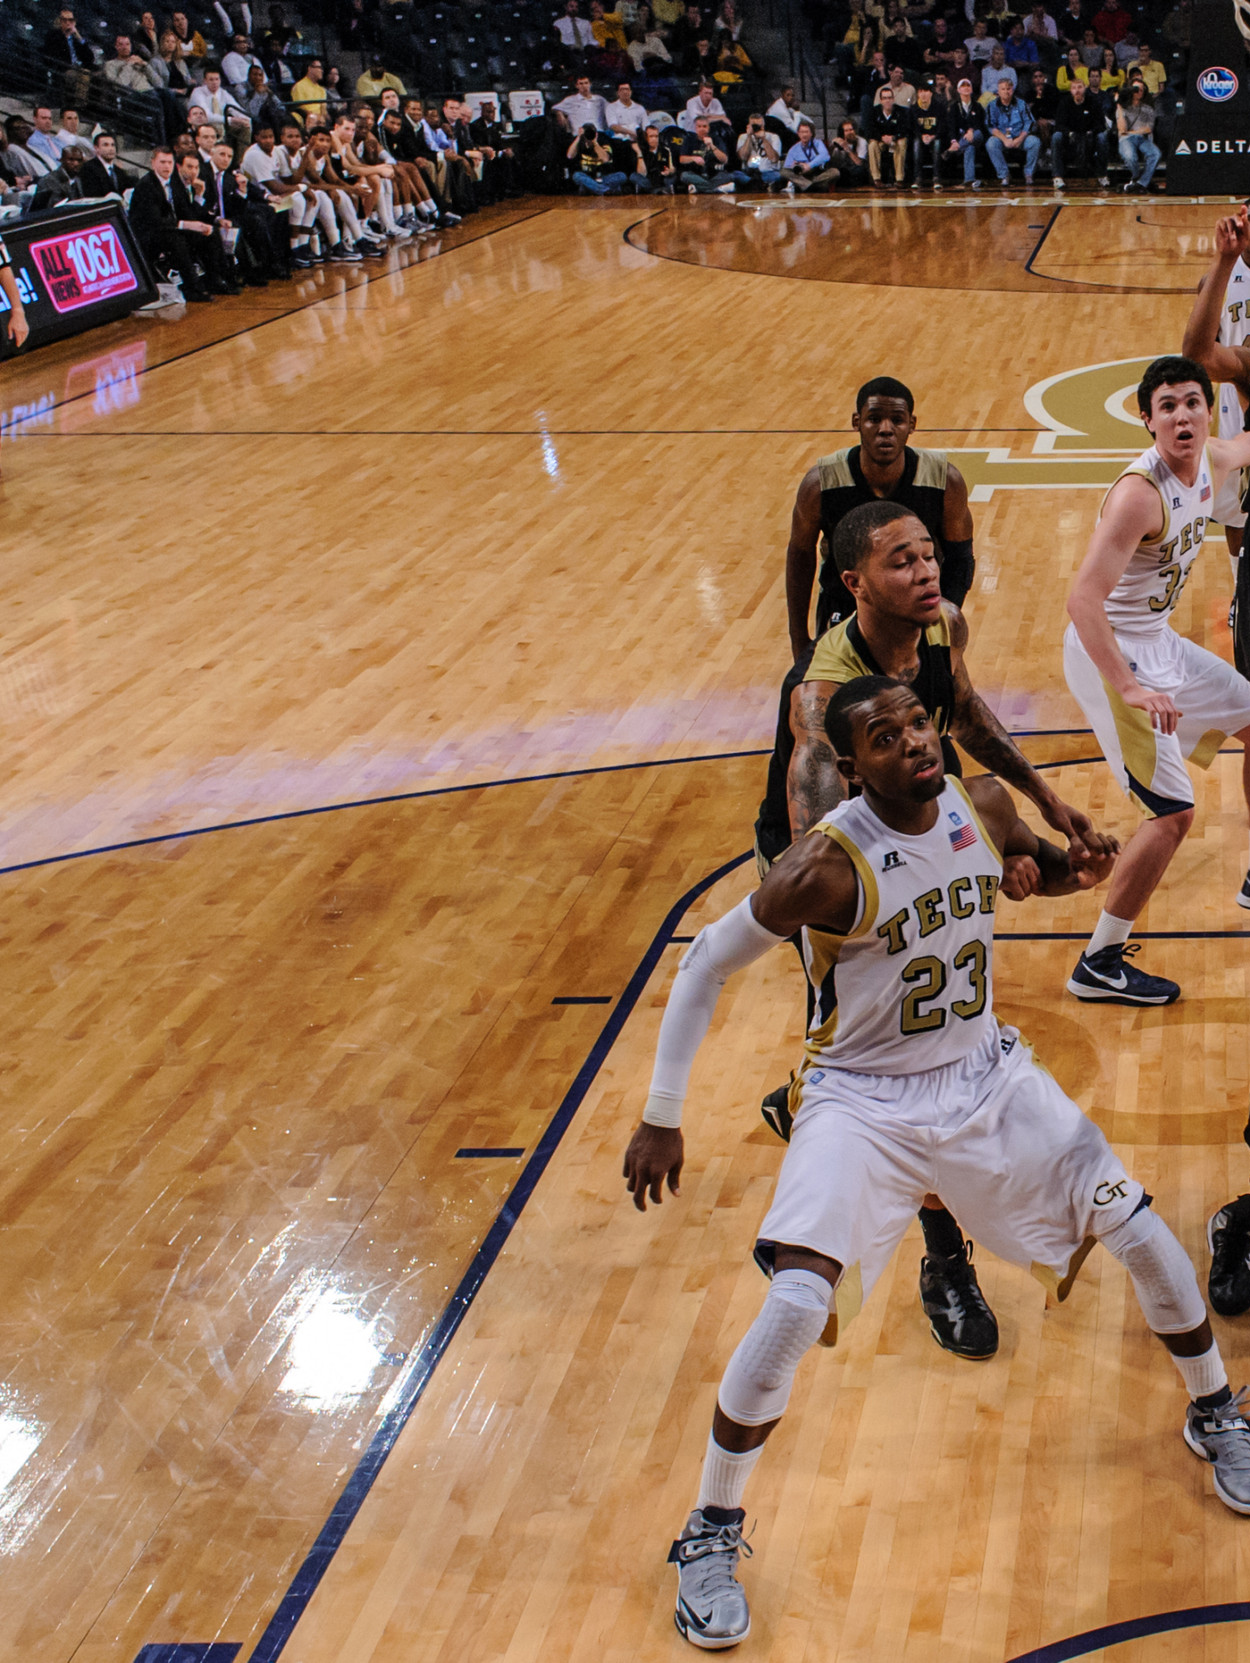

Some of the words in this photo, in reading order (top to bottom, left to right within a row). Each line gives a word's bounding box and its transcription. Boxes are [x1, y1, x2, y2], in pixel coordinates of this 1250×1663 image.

[1202, 72, 1235, 97] Kroger
[40, 245, 72, 281] ALL
[66, 230, 121, 284] 106.7
[51, 276, 81, 303] NEWS
[1158, 516, 1211, 564] TEC
[877, 874, 1000, 956] TECH
[900, 938, 988, 1036] 23
[1093, 1179, 1128, 1206] GT
